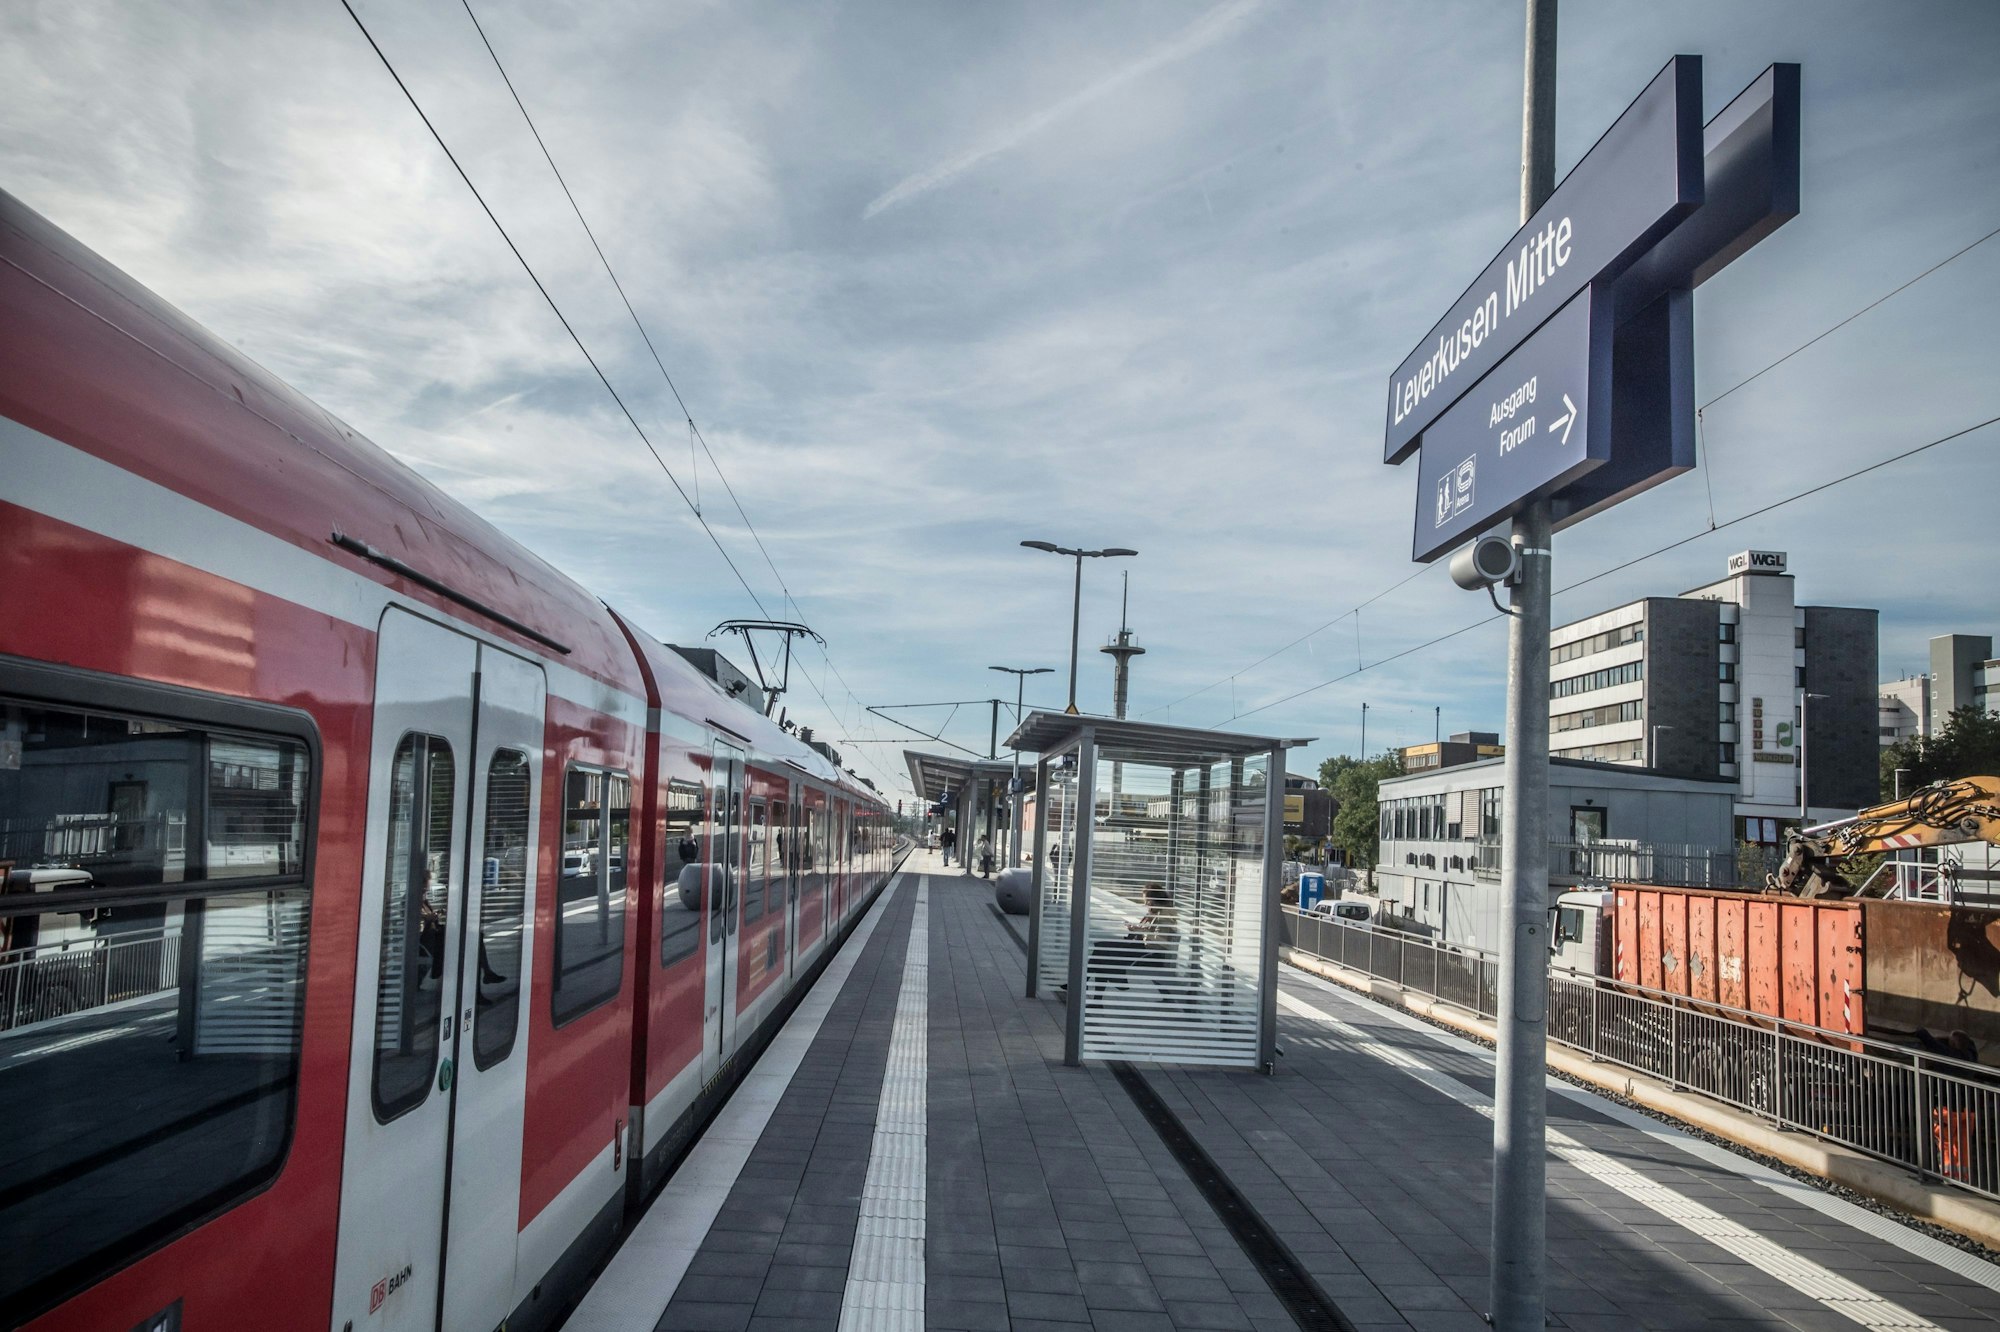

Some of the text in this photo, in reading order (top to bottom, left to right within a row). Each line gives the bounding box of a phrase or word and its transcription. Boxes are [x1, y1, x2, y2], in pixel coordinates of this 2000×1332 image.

[1394, 216, 1572, 426] Leverkusen Mitte
[1489, 375, 1537, 429] Ausgang
[1500, 415, 1536, 457] Forum
[1456, 493, 1470, 507] Arena
[1729, 555, 1747, 570] WGL
[1750, 553, 1785, 567] WGL
[941, 792, 948, 803] 2
[371, 1263, 412, 1310] DB BAHN
